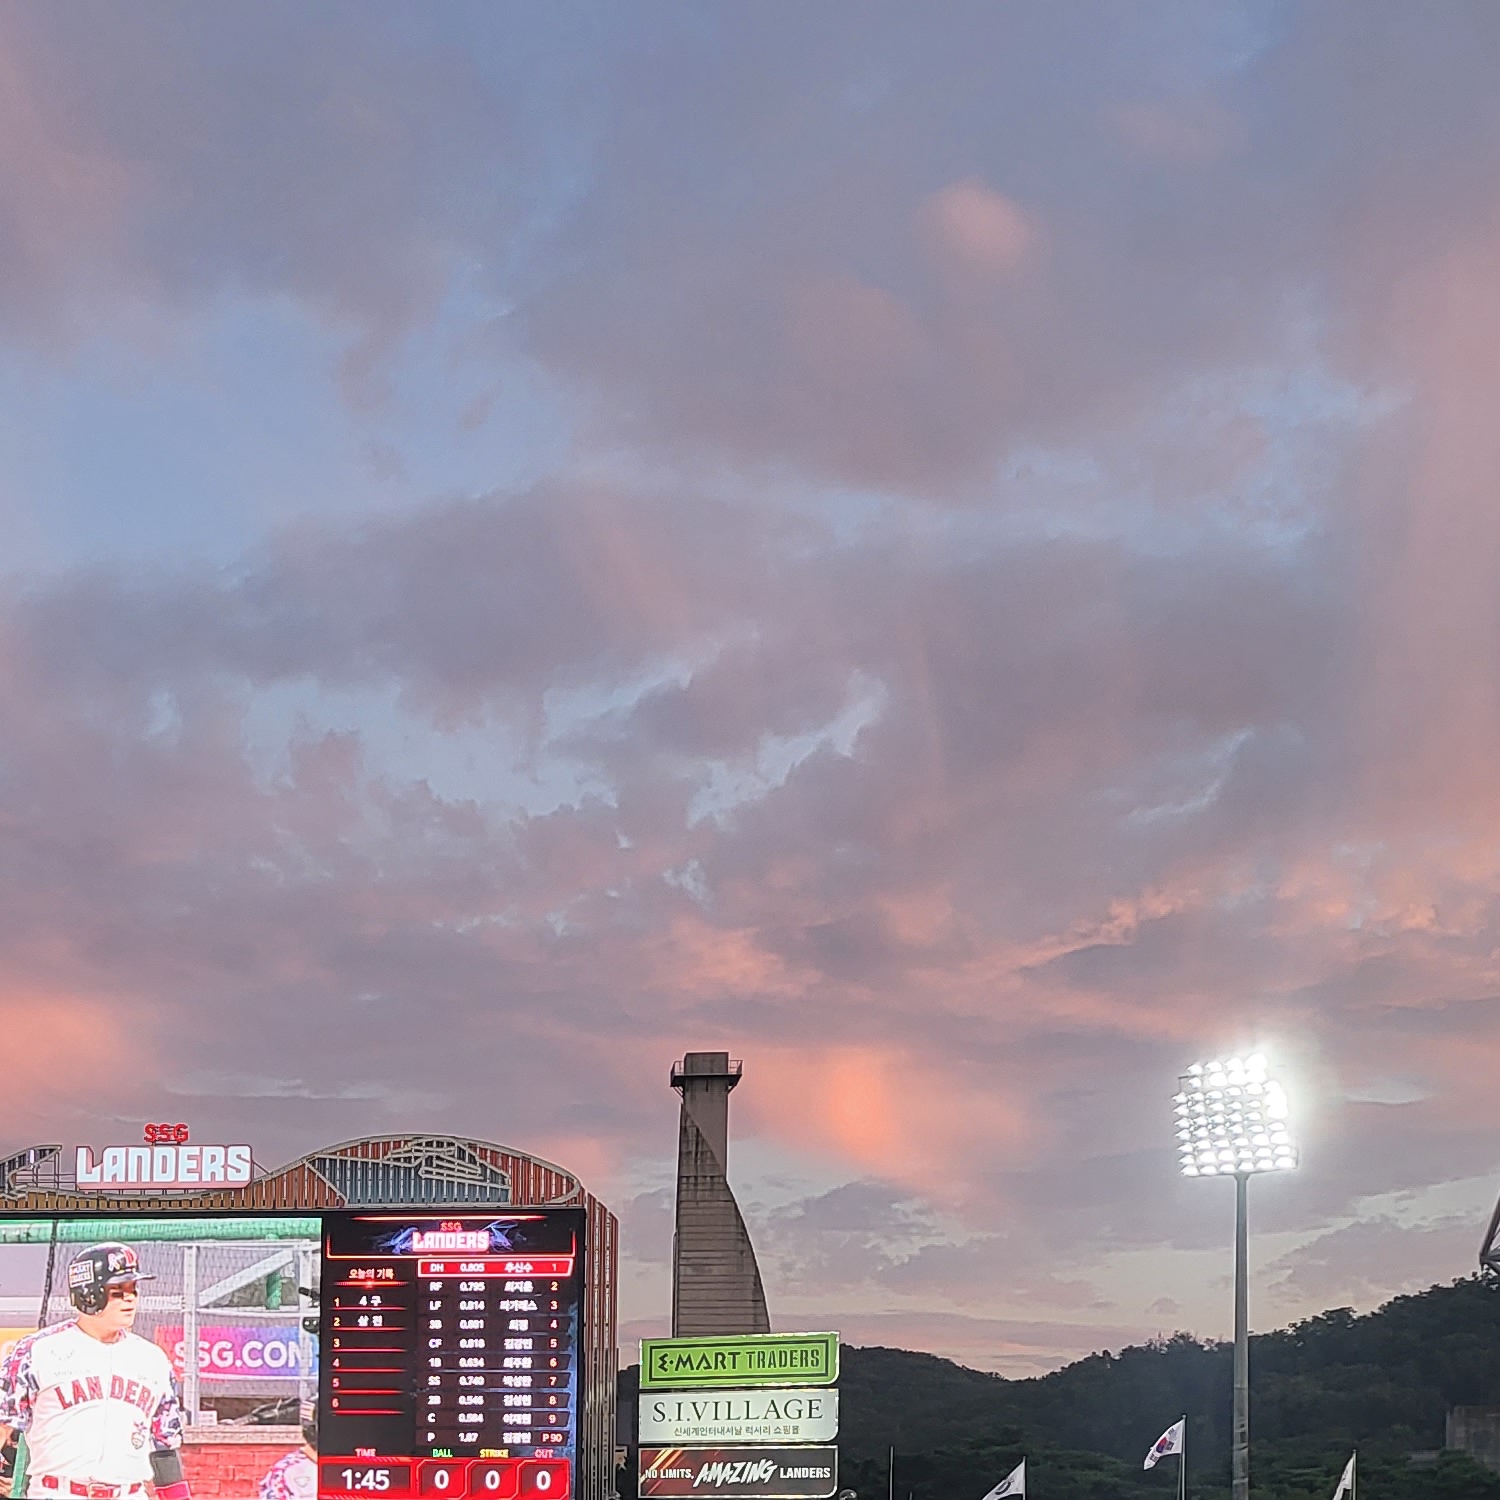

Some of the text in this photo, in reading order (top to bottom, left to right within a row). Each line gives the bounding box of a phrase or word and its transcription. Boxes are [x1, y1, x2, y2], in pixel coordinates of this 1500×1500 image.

[144, 1124, 188, 1142] SSG
[77, 1145, 250, 1183] LANDERS
[440, 1221, 462, 1231] SSG
[412, 1231, 489, 1251] LANDERS
[349, 1268, 374, 1279] 오늘의
[550, 1281, 558, 1292] 2
[550, 1300, 558, 1310] 3
[333, 1317, 340, 1327] 2
[550, 1319, 558, 1329] 4
[333, 1338, 340, 1348] 3
[550, 1338, 558, 1349] 5
[332, 1357, 340, 1368] 4
[549, 1357, 557, 1368] 6
[745, 1348, 820, 1369] TRADERS
[332, 1377, 340, 1387] 5
[549, 1376, 557, 1386] 7
[652, 1398, 824, 1423] S.I.VILLAGE
[355, 1448, 554, 1458] TIME BALL STRIKE OUT
[645, 1468, 658, 1479] NO
[693, 1458, 778, 1488] AMAZING
[779, 1466, 831, 1479] LANDERS
[341, 1469, 551, 1491] 1:45 0 0 0
